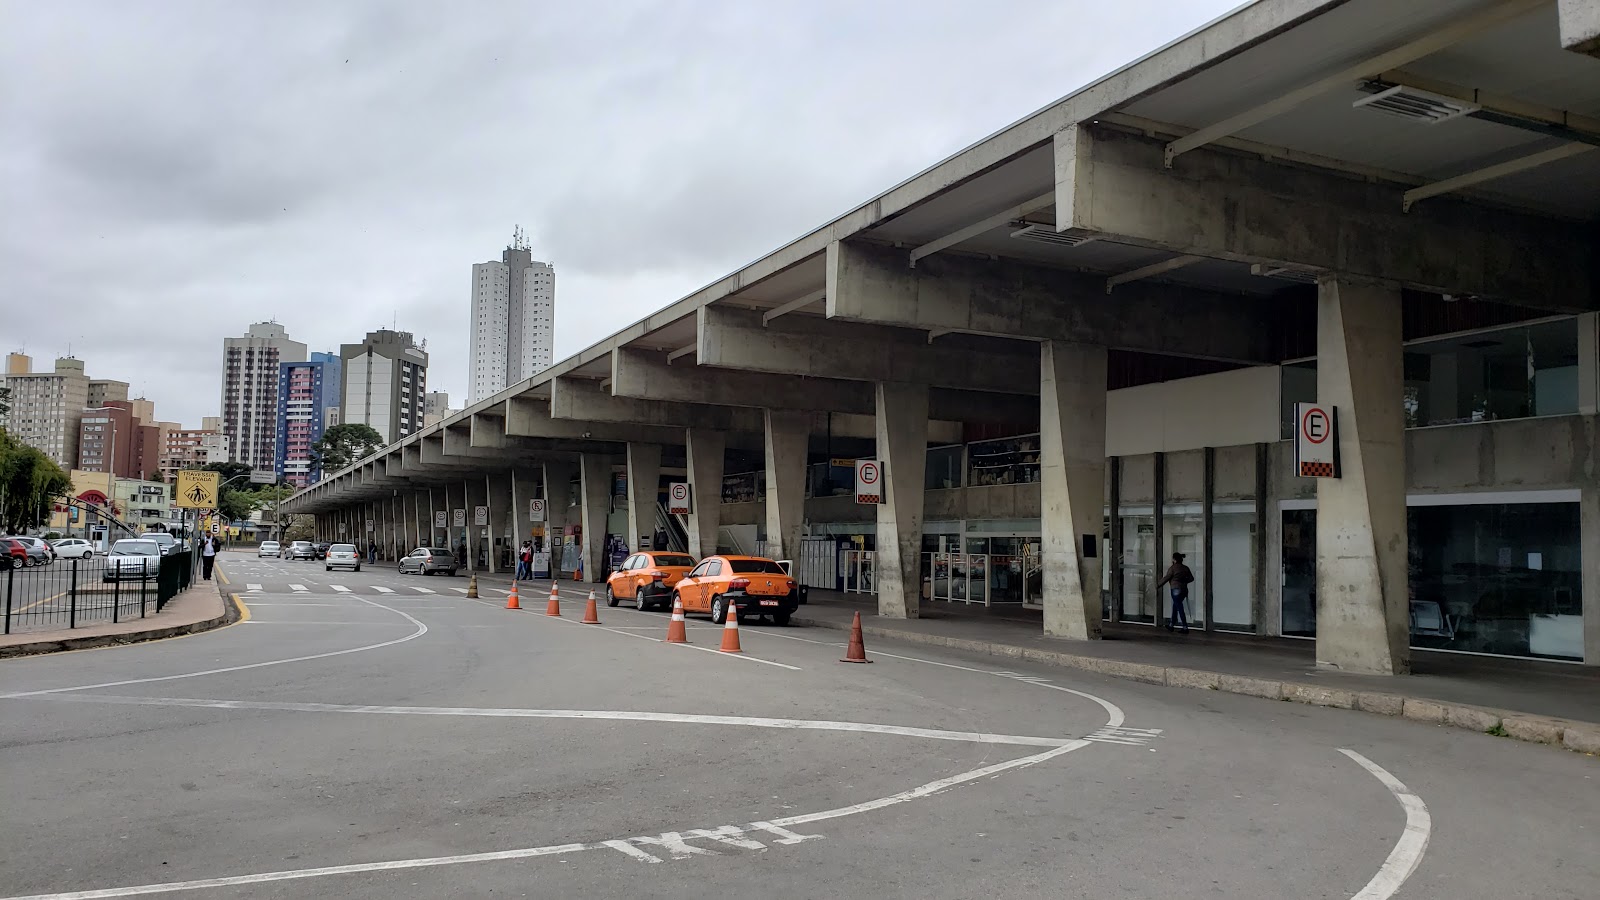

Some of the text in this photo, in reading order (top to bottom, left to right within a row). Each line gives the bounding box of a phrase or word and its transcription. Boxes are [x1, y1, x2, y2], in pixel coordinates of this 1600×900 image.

[1310, 414, 1322, 437] E
[864, 466, 874, 481] E
[676, 487, 683, 498] E
[212, 524, 218, 533] E
